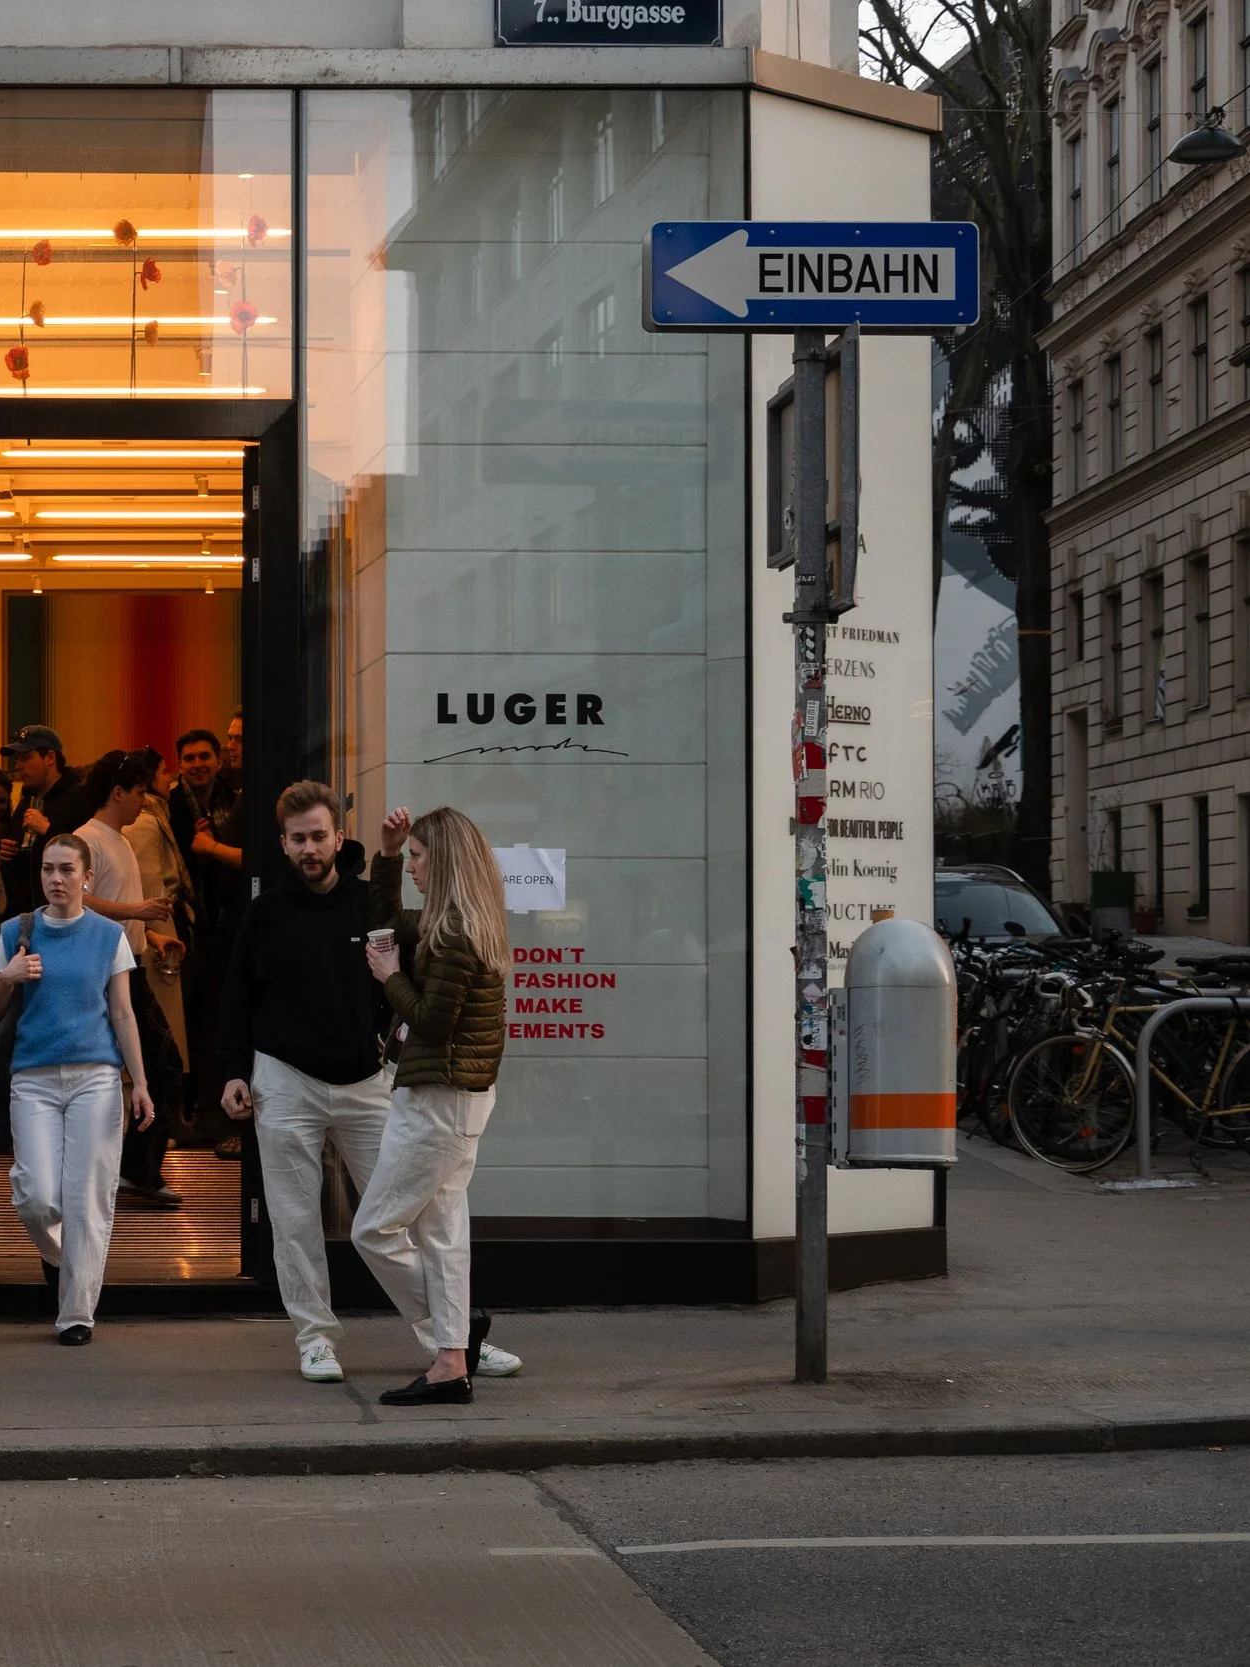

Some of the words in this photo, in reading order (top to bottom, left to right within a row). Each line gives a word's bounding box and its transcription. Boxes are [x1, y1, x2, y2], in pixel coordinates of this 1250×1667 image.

[566, 0, 686, 30] Burggasse
[759, 253, 939, 294] EINBAHN
[842, 628, 900, 644] FRIEDMAN
[437, 692, 605, 725] LUGER
[859, 781, 885, 800] RIO
[840, 819, 878, 840] BEAUTIFUL
[878, 821, 904, 841] PEOPLE
[525, 875, 554, 885] OPEN
[853, 859, 898, 883] Koenig
[514, 973, 617, 989] FASHION
[515, 998, 583, 1014] MAKE
